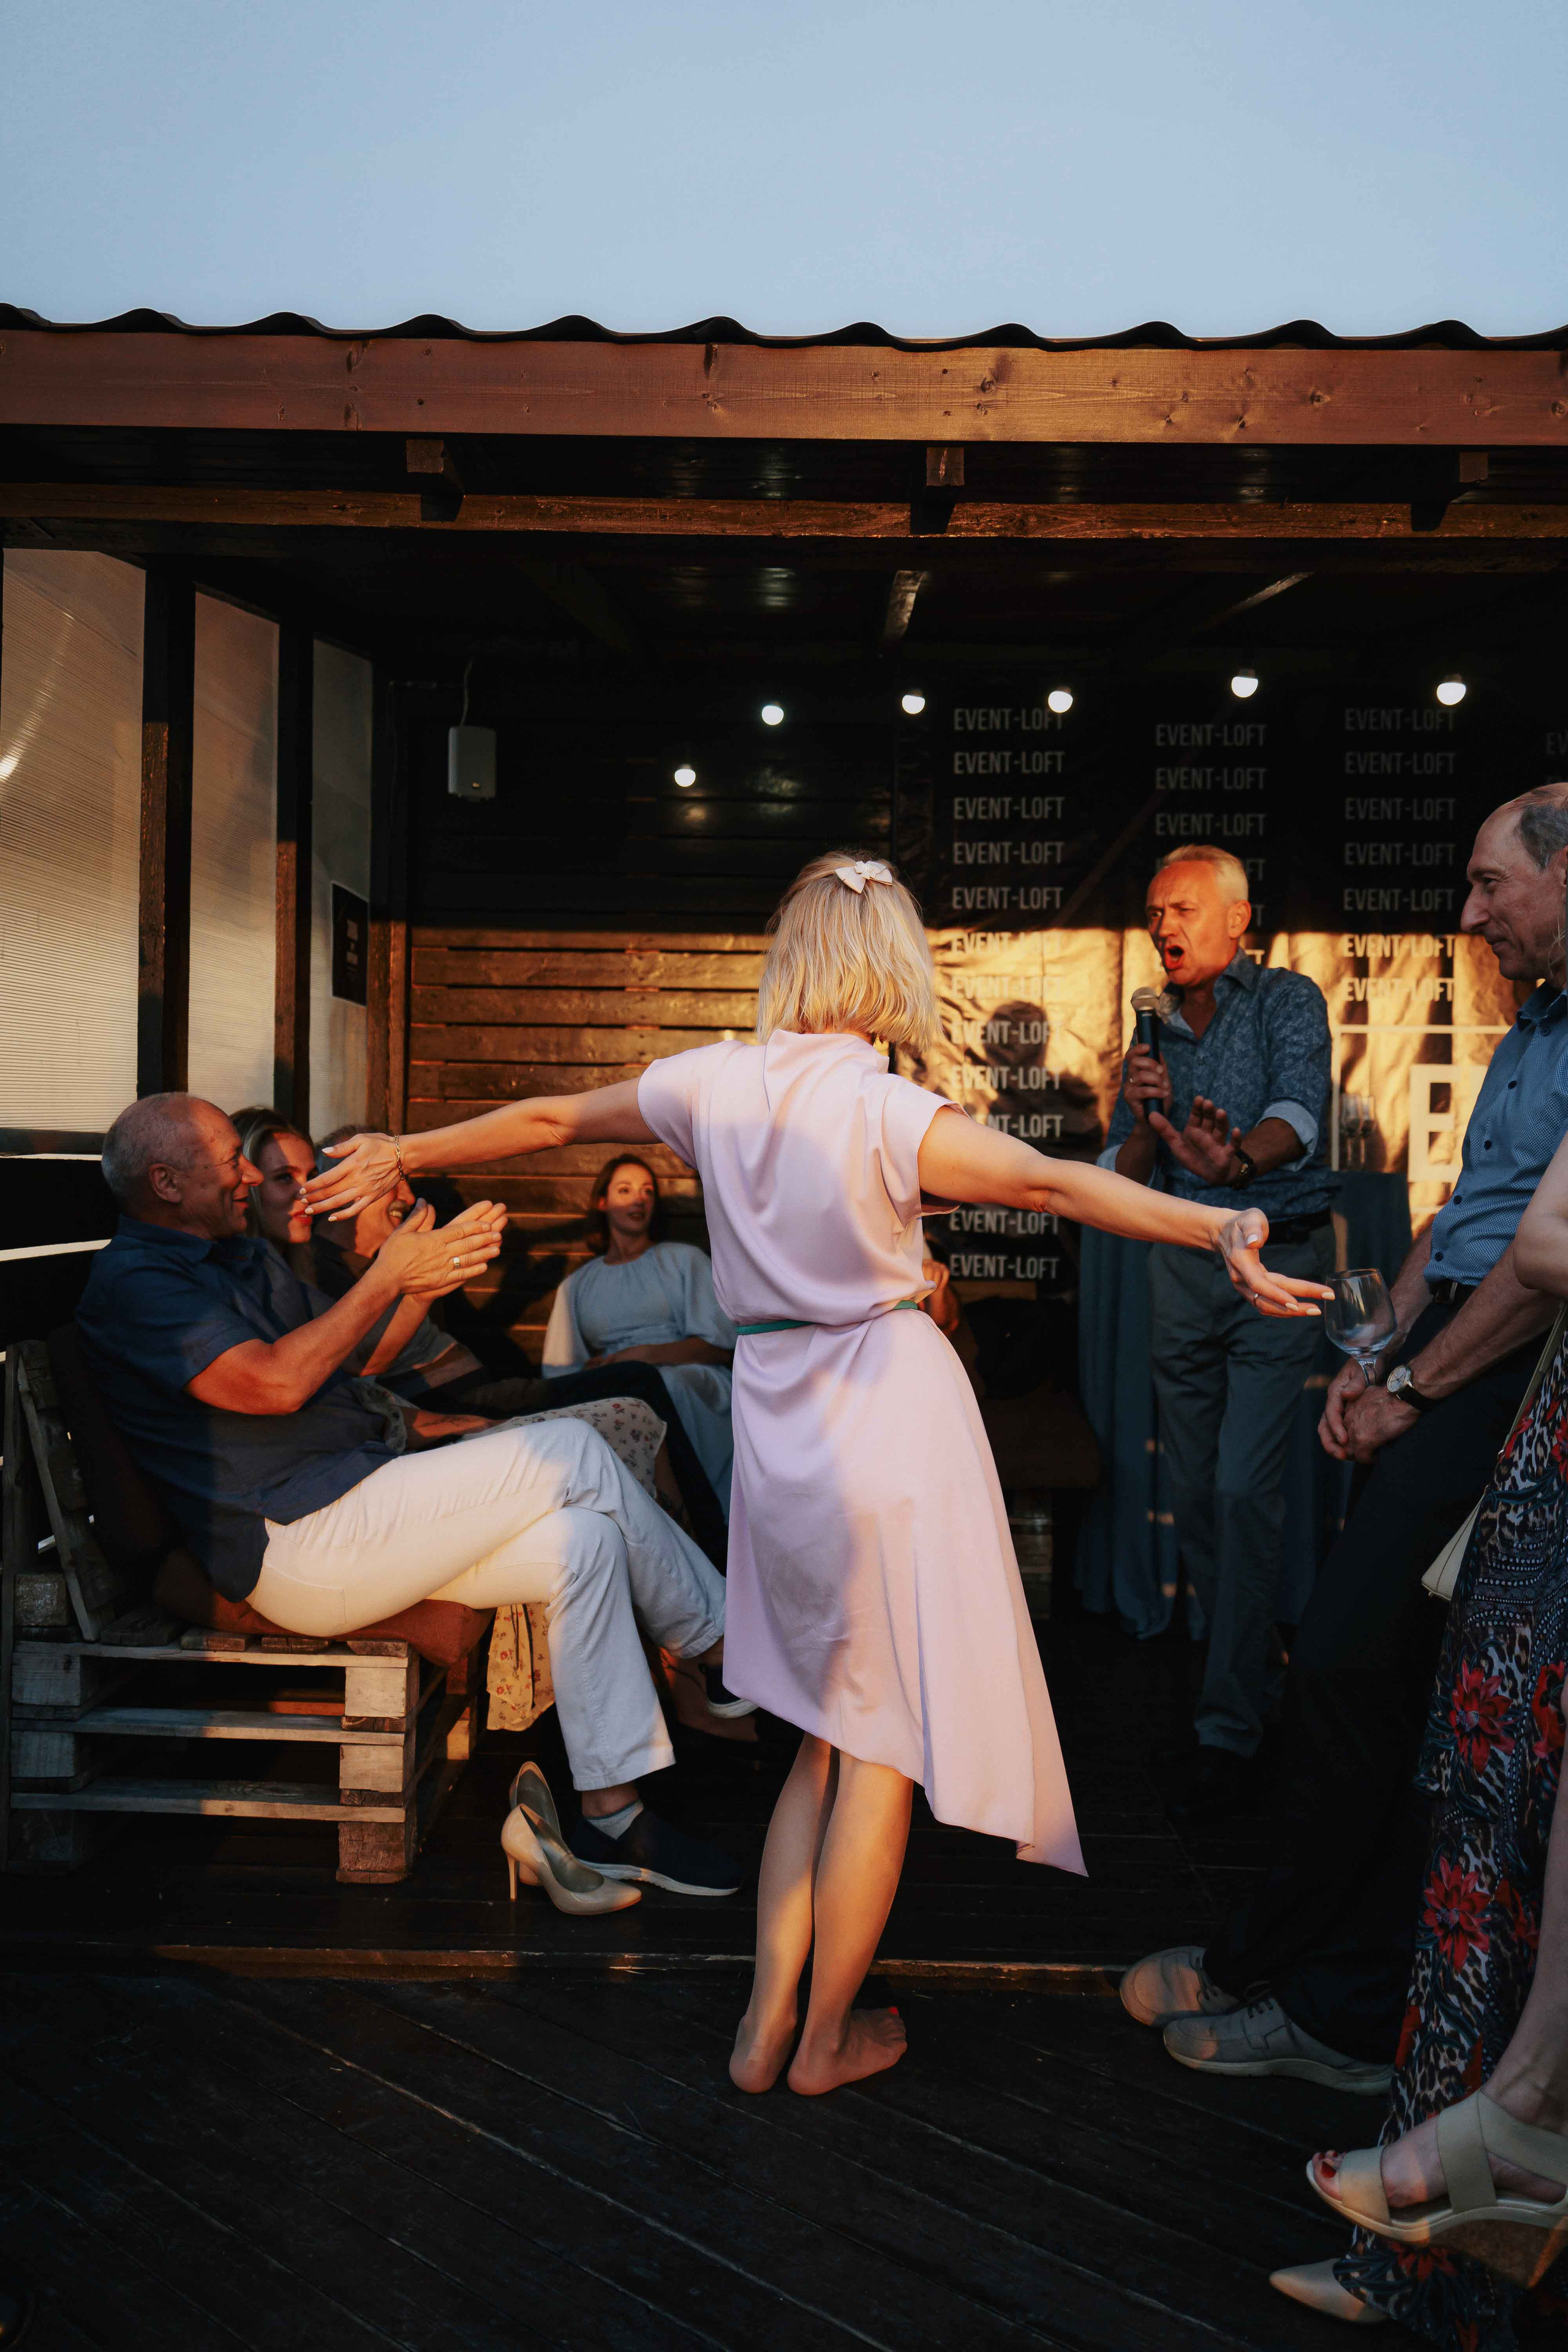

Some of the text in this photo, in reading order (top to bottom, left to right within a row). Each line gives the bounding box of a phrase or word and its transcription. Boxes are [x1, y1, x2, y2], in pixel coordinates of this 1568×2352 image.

[954, 708, 1064, 731] EVENT-LOFT
[1344, 707, 1456, 731] EVENT-LOFT
[1155, 724, 1267, 747] EVENT-LOFT
[954, 751, 1065, 774] EVENT-LOFT
[1344, 752, 1457, 775] EVENT-LOFT
[1155, 767, 1267, 791] EVENT-LOFT
[954, 796, 1065, 820] EVENT-LOFT
[1344, 797, 1457, 821] EVENT-LOFT
[1155, 813, 1267, 837] EVENT-LOFT
[952, 842, 1065, 864] EVENT-LOFT
[1344, 843, 1457, 866] EVENT-LOFT
[952, 887, 1063, 910] EVENT-LOFT
[1343, 888, 1455, 912] EVENT-LOFT
[949, 1210, 1059, 1235] EVENT-LOFT
[950, 1254, 1060, 1280] EVENT-LOFT
